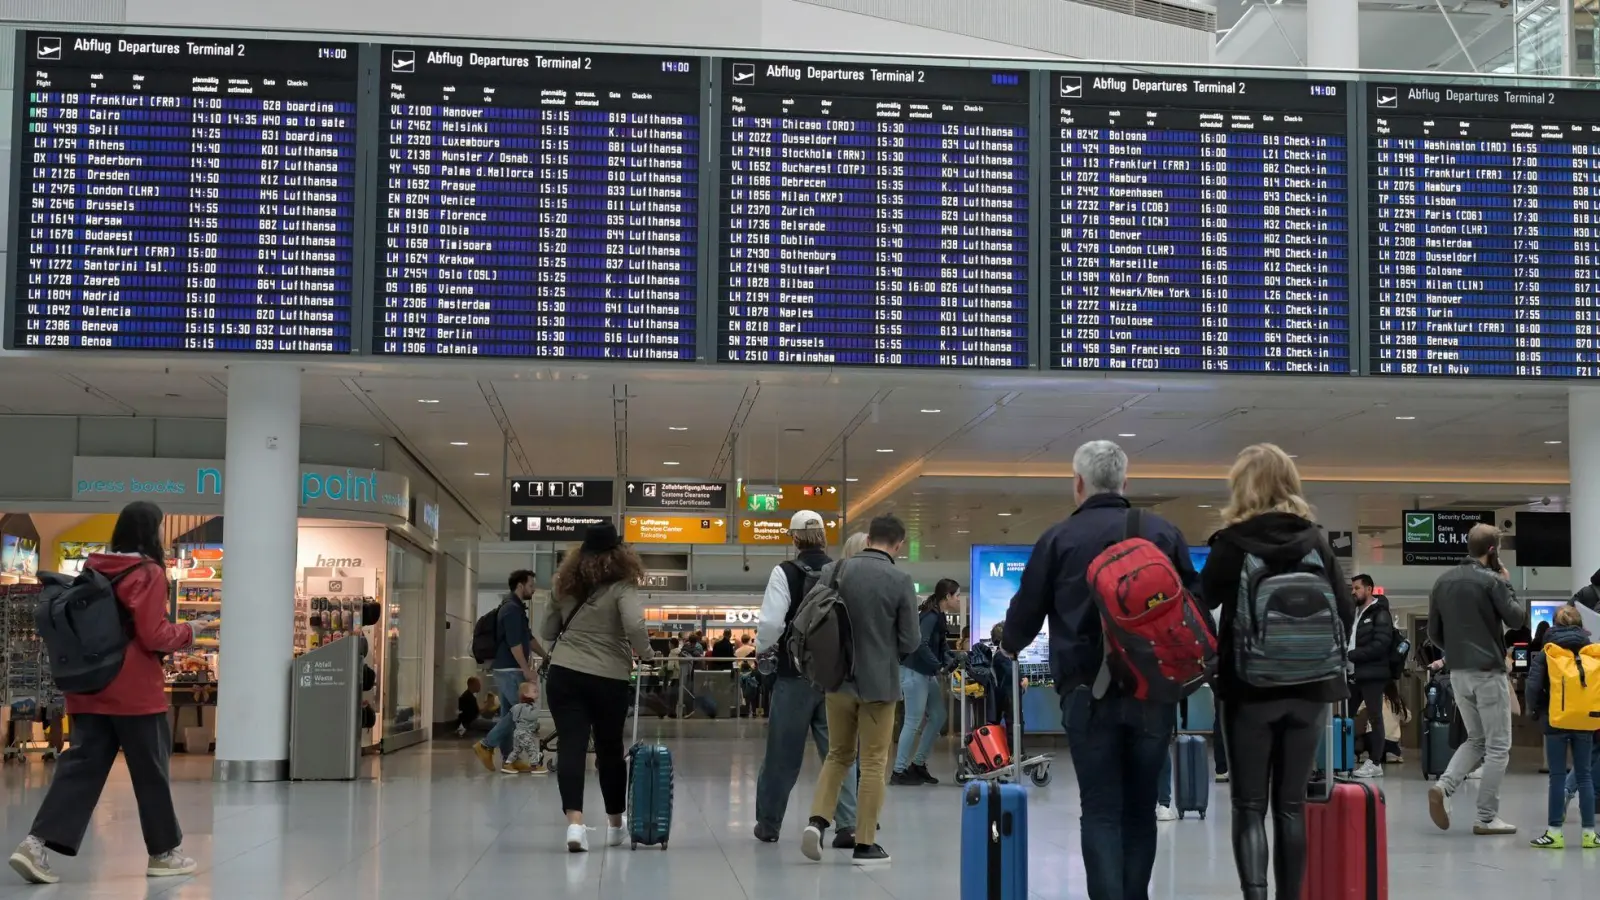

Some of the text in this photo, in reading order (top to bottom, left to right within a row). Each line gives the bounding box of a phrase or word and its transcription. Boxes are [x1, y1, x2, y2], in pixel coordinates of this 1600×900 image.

[74, 38, 244, 56] Abflug Departures Terminal 2
[319, 48, 346, 58] 14:00
[427, 52, 591, 69] Abflug Departures Terminal 2
[662, 62, 689, 72] 14:00
[767, 65, 924, 82] Abflug Departures Terminal 2
[1093, 78, 1245, 93] Abflug Departures Terminal 2
[1311, 86, 1336, 95] 14:00
[1408, 88, 1554, 104] Abflug Departures Terminal 2
[59, 109, 78, 118] 788
[89, 110, 119, 120] Cairo
[192, 113, 221, 123] 14:10
[227, 114, 256, 124] 14:35
[286, 118, 297, 126] go
[304, 117, 315, 126] to
[321, 118, 344, 127] gate
[390, 120, 402, 129] LH
[407, 120, 431, 130] 2462
[442, 122, 487, 132] Helsinki
[541, 125, 568, 135] 15:15
[631, 128, 682, 139] Lufthansa
[34, 138, 338, 157] LH 1754 Athens 14:40 K01 Lufthansa
[1060, 143, 1326, 160] LH 424 Boston 16:00 L21 Check-in
[1377, 153, 1537, 166] LH 1948 Berlin 17:00
[33, 168, 337, 186] LH 2126 Dresden 14:50 K12 Lufthansa
[31, 198, 336, 216] SN 2646 Brussels 14:55 K14 Lufthansa
[730, 219, 741, 228] LH
[748, 219, 769, 229] 1736
[780, 220, 825, 231] Belgrade
[876, 223, 903, 233] 15:40
[963, 226, 1012, 236] Lufthansa
[1082, 229, 1097, 238] 761
[1109, 230, 1141, 239] Denver
[1201, 232, 1227, 242] 16:05
[1285, 234, 1327, 244] Check-in
[1379, 293, 1539, 305] LH 2104 Hanover 17:55
[385, 313, 396, 322] LH
[403, 313, 426, 323] 1814
[437, 314, 489, 324] Barcelona
[537, 316, 564, 326] 15:30
[627, 319, 679, 329] Lufthansa
[729, 306, 1011, 322] VL 1878 Naples 15:50 K01 Lufthansa
[1379, 335, 1540, 347] LH 2388 Geneva 18:00
[77, 479, 124, 495] press
[130, 477, 186, 494] books
[316, 554, 362, 566] hama
[990, 562, 1004, 577] M
